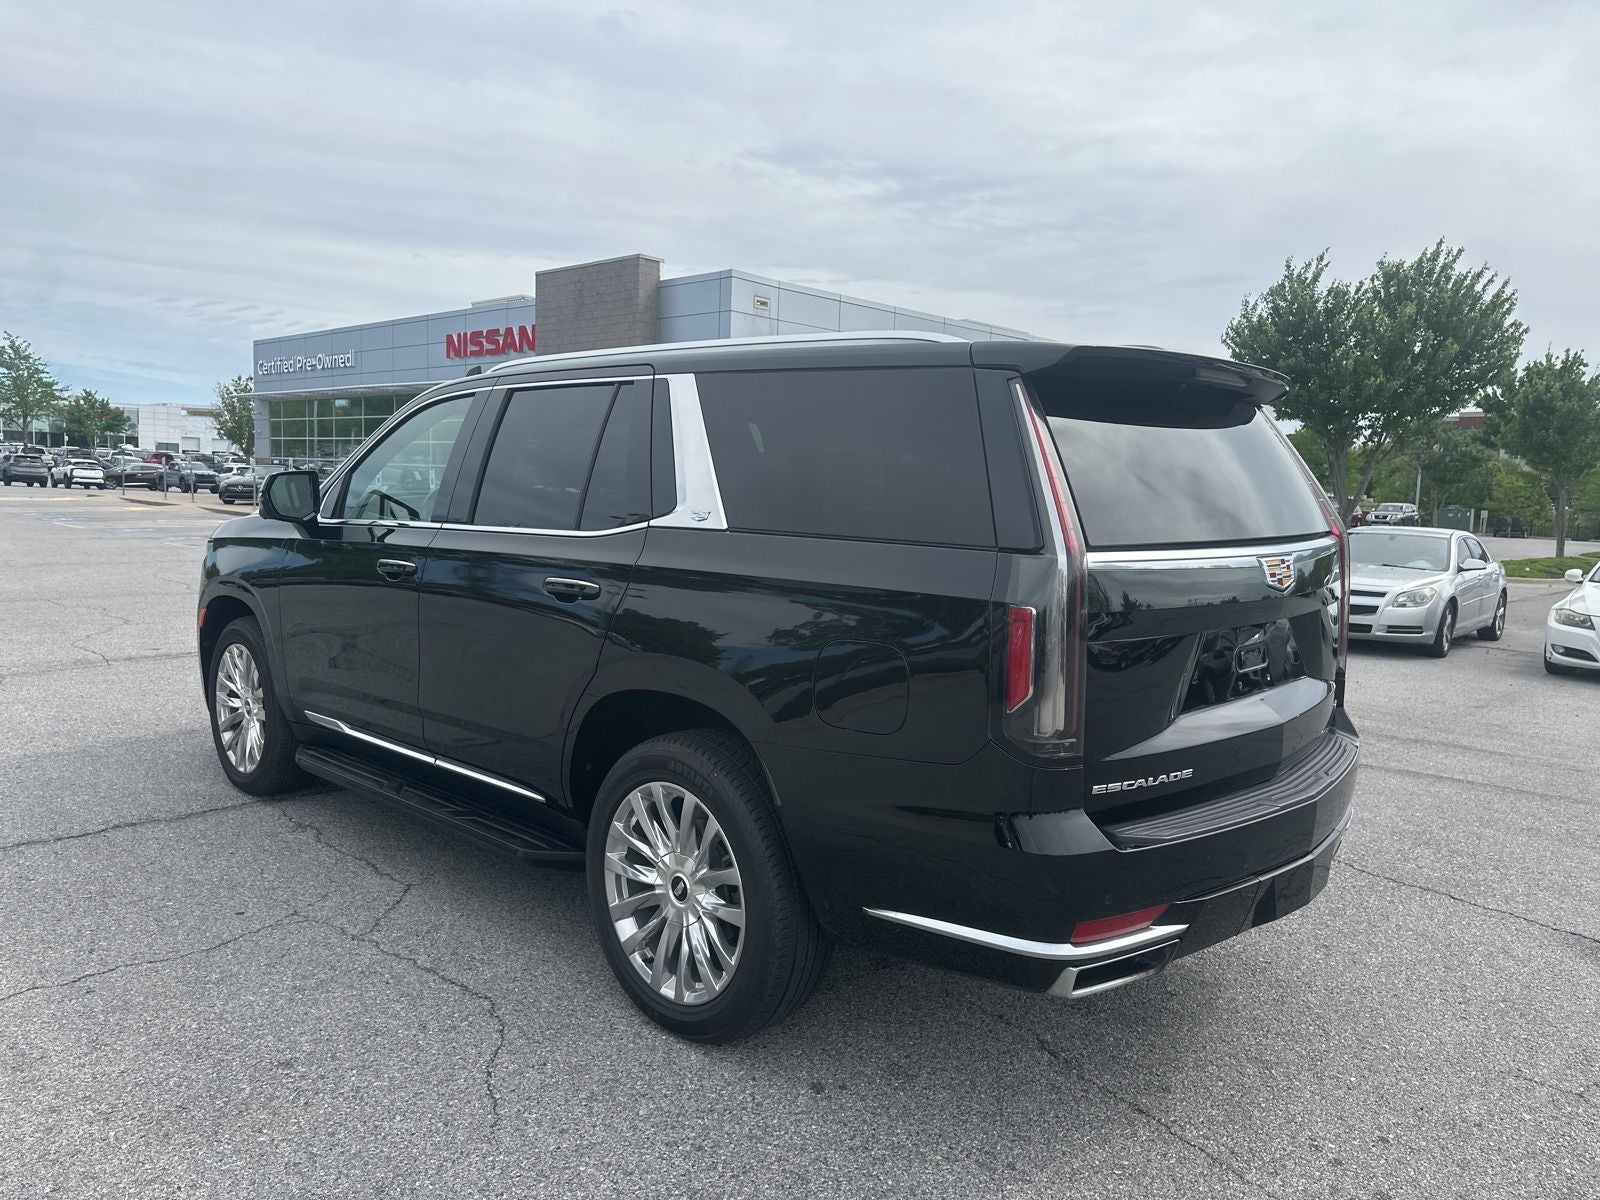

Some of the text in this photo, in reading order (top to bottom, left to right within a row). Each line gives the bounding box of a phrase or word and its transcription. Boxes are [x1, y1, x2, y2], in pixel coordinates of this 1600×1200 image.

[446, 324, 536, 359] NISSAN
[257, 355, 294, 375] Certified
[1092, 769, 1194, 795] ESCALADE
